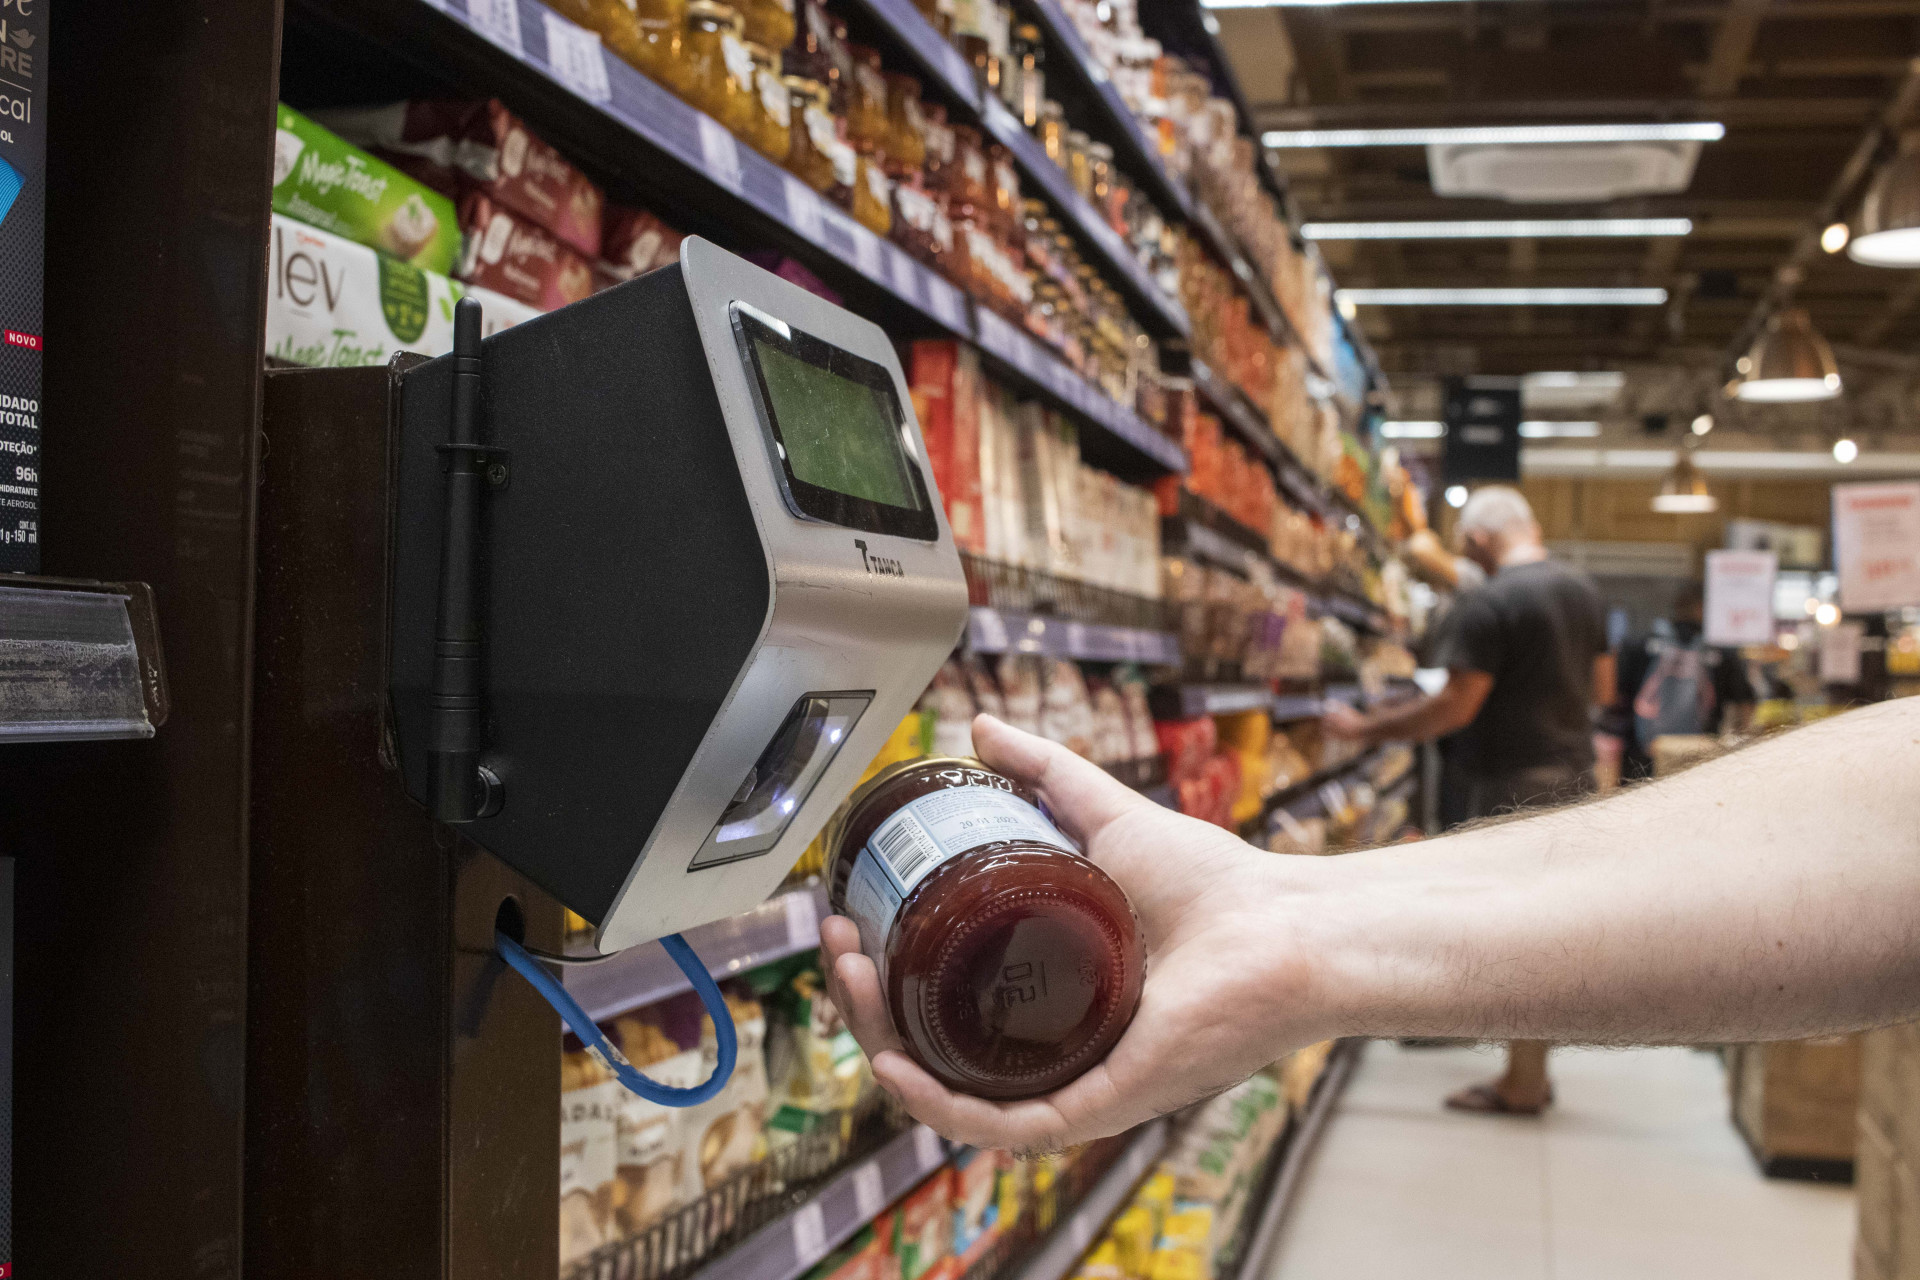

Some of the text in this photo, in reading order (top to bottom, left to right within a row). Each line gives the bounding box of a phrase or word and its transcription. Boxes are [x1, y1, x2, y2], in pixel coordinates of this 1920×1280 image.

[276, 226, 346, 314] lev
[9, 332, 37, 347] NOVO
[0, 410, 38, 429] TOTAL
[15, 466, 38, 482] 96h
[7, 500, 37, 510] AEROSOL
[869, 555, 905, 578] TANCA
